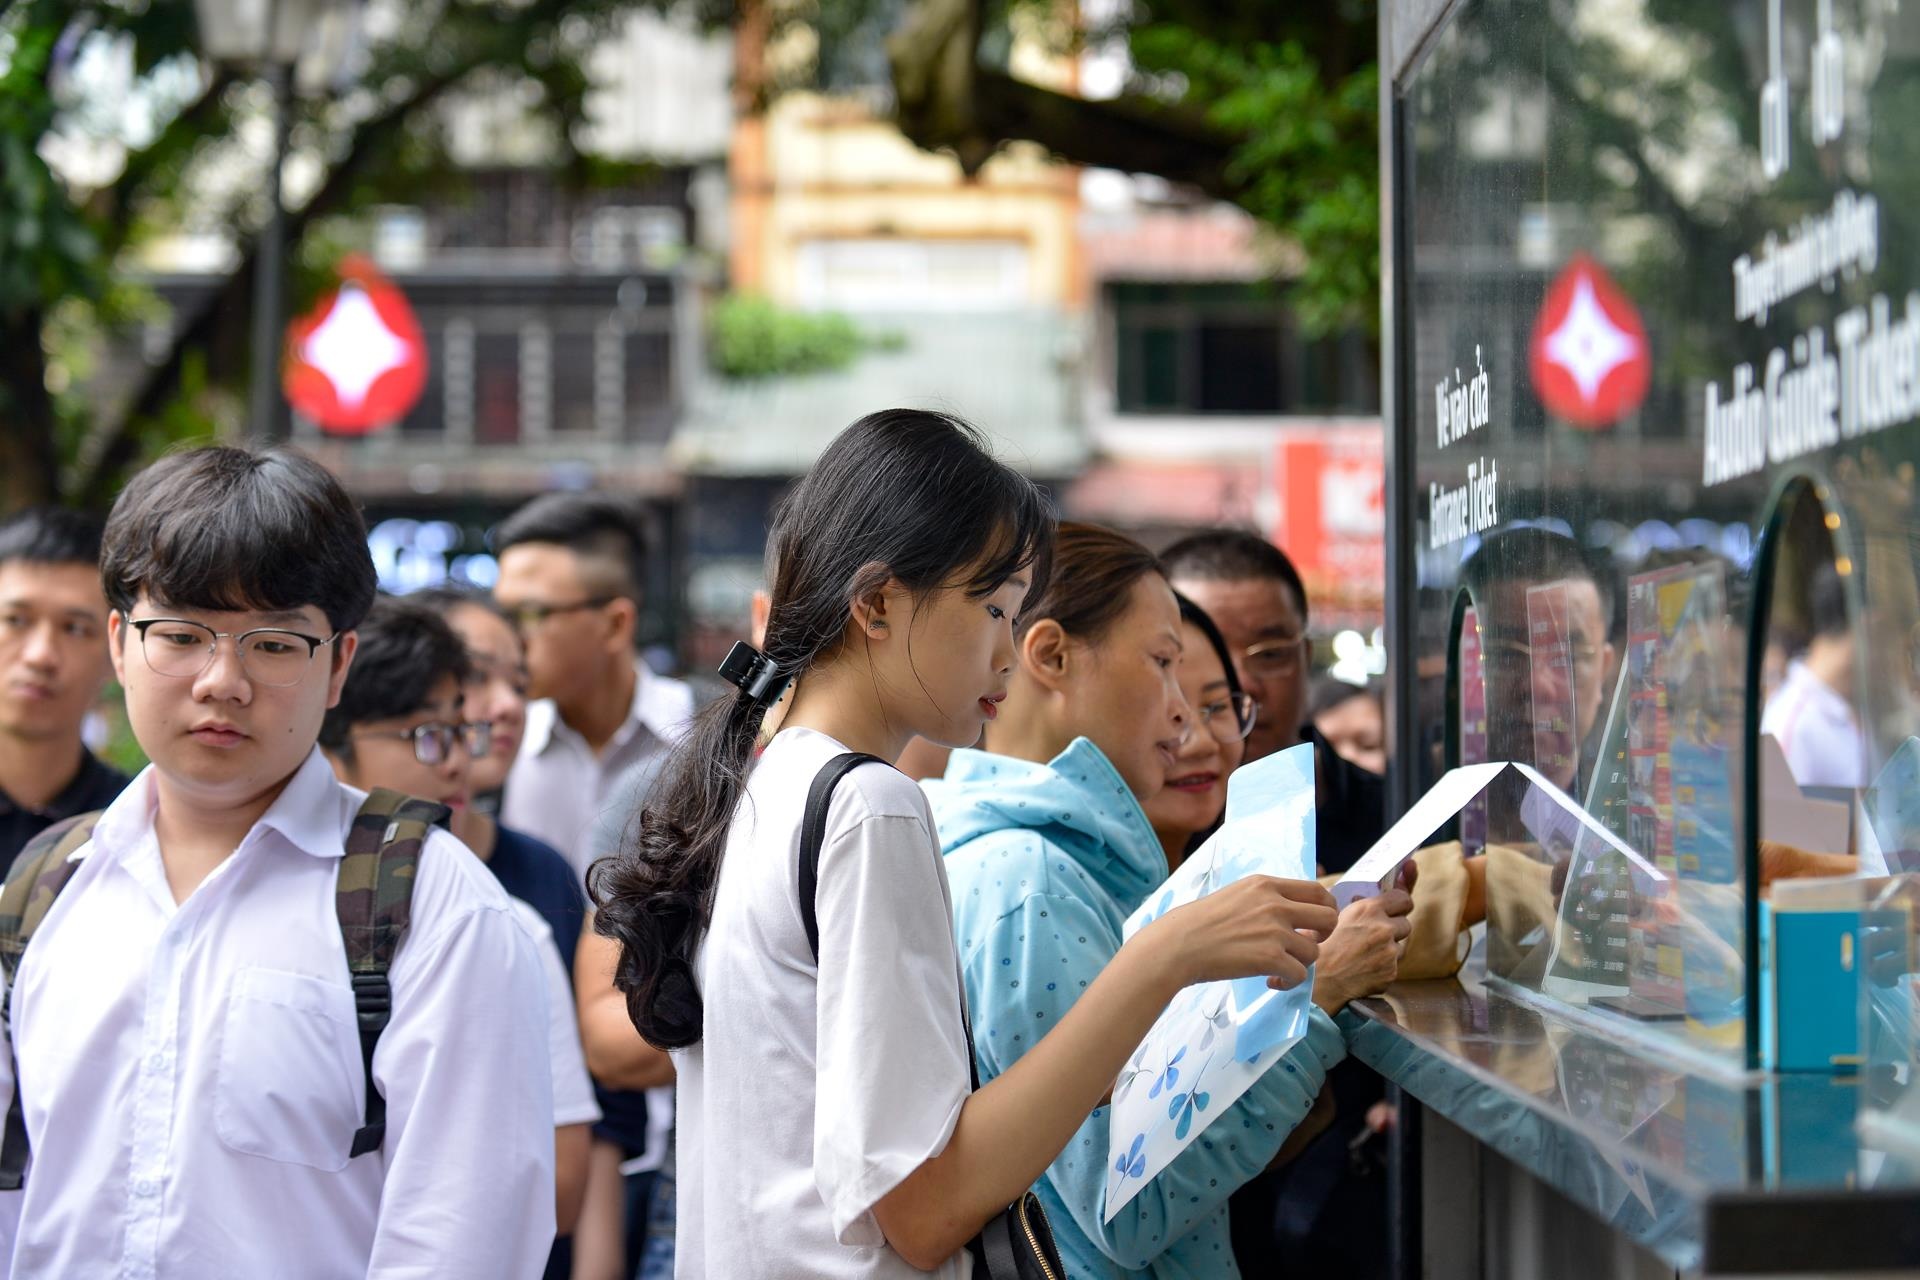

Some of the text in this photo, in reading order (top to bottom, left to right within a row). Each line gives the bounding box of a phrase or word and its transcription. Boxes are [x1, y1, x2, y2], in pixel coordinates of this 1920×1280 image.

[1435, 343, 1489, 449] Vé vào cửa
[1703, 362, 1764, 487] Audio
[1765, 325, 1839, 463] Guide
[1430, 481, 1468, 549] Entrance
[1468, 456, 1497, 534] Ticket
